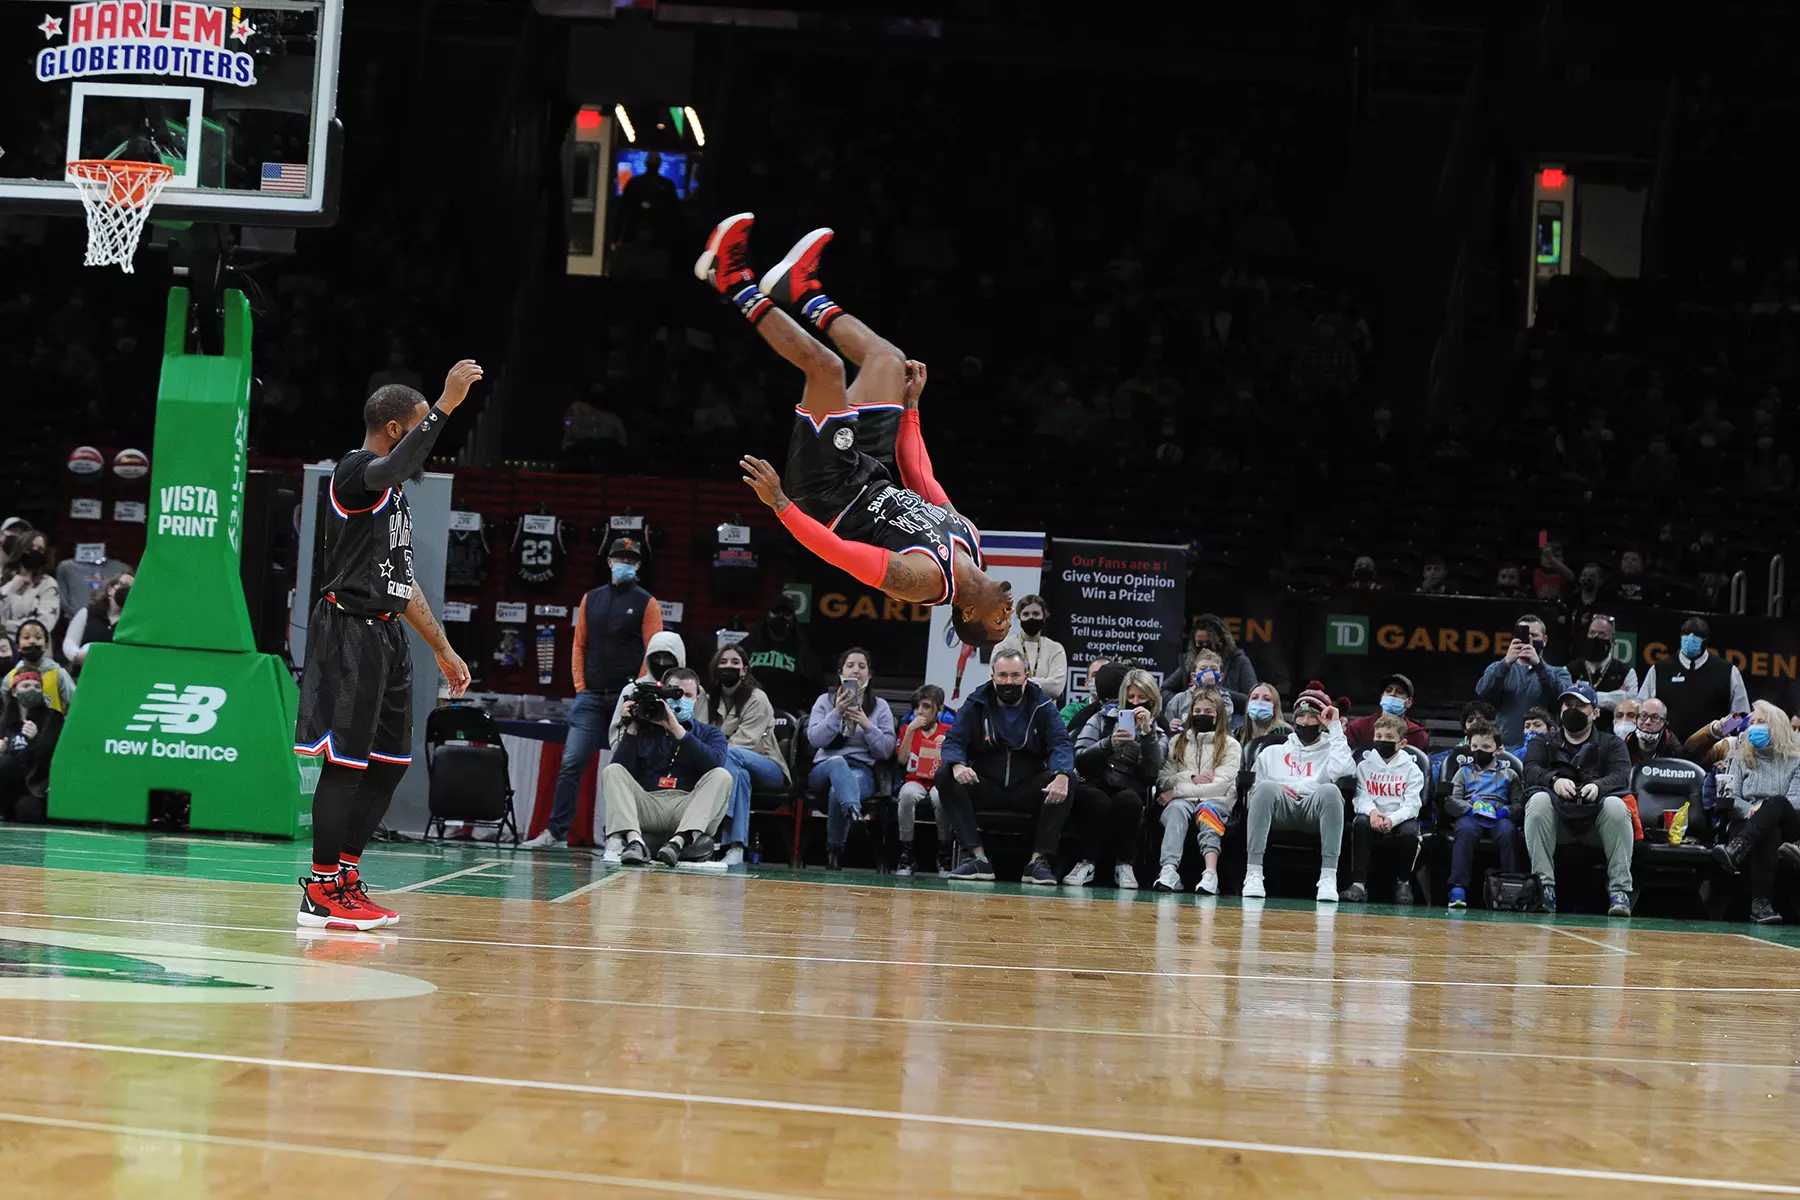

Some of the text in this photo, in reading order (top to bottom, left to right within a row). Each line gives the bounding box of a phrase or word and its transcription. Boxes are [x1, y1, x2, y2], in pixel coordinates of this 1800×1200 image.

[72, 2, 222, 47] HARLEM
[41, 45, 250, 83] GLOBETROTTERS
[160, 485, 218, 516] VISTA
[158, 514, 218, 537] PRINT
[522, 539, 552, 565] 23
[1072, 555, 1096, 567] Our
[1099, 557, 1127, 569] Fans
[1129, 561, 1150, 570] are
[1062, 570, 1175, 588] Give Your Opinion
[1081, 587, 1155, 602] Win a Prize!
[1070, 613, 1163, 629] Scan this QR code.
[1071, 626, 1161, 643] Tell us about your
[1331, 621, 1514, 655] TD GARDE
[1087, 641, 1144, 653] experience
[1072, 652, 1083, 662] at
[105, 738, 238, 762] new balance
[1652, 767, 1696, 779] Putnam
